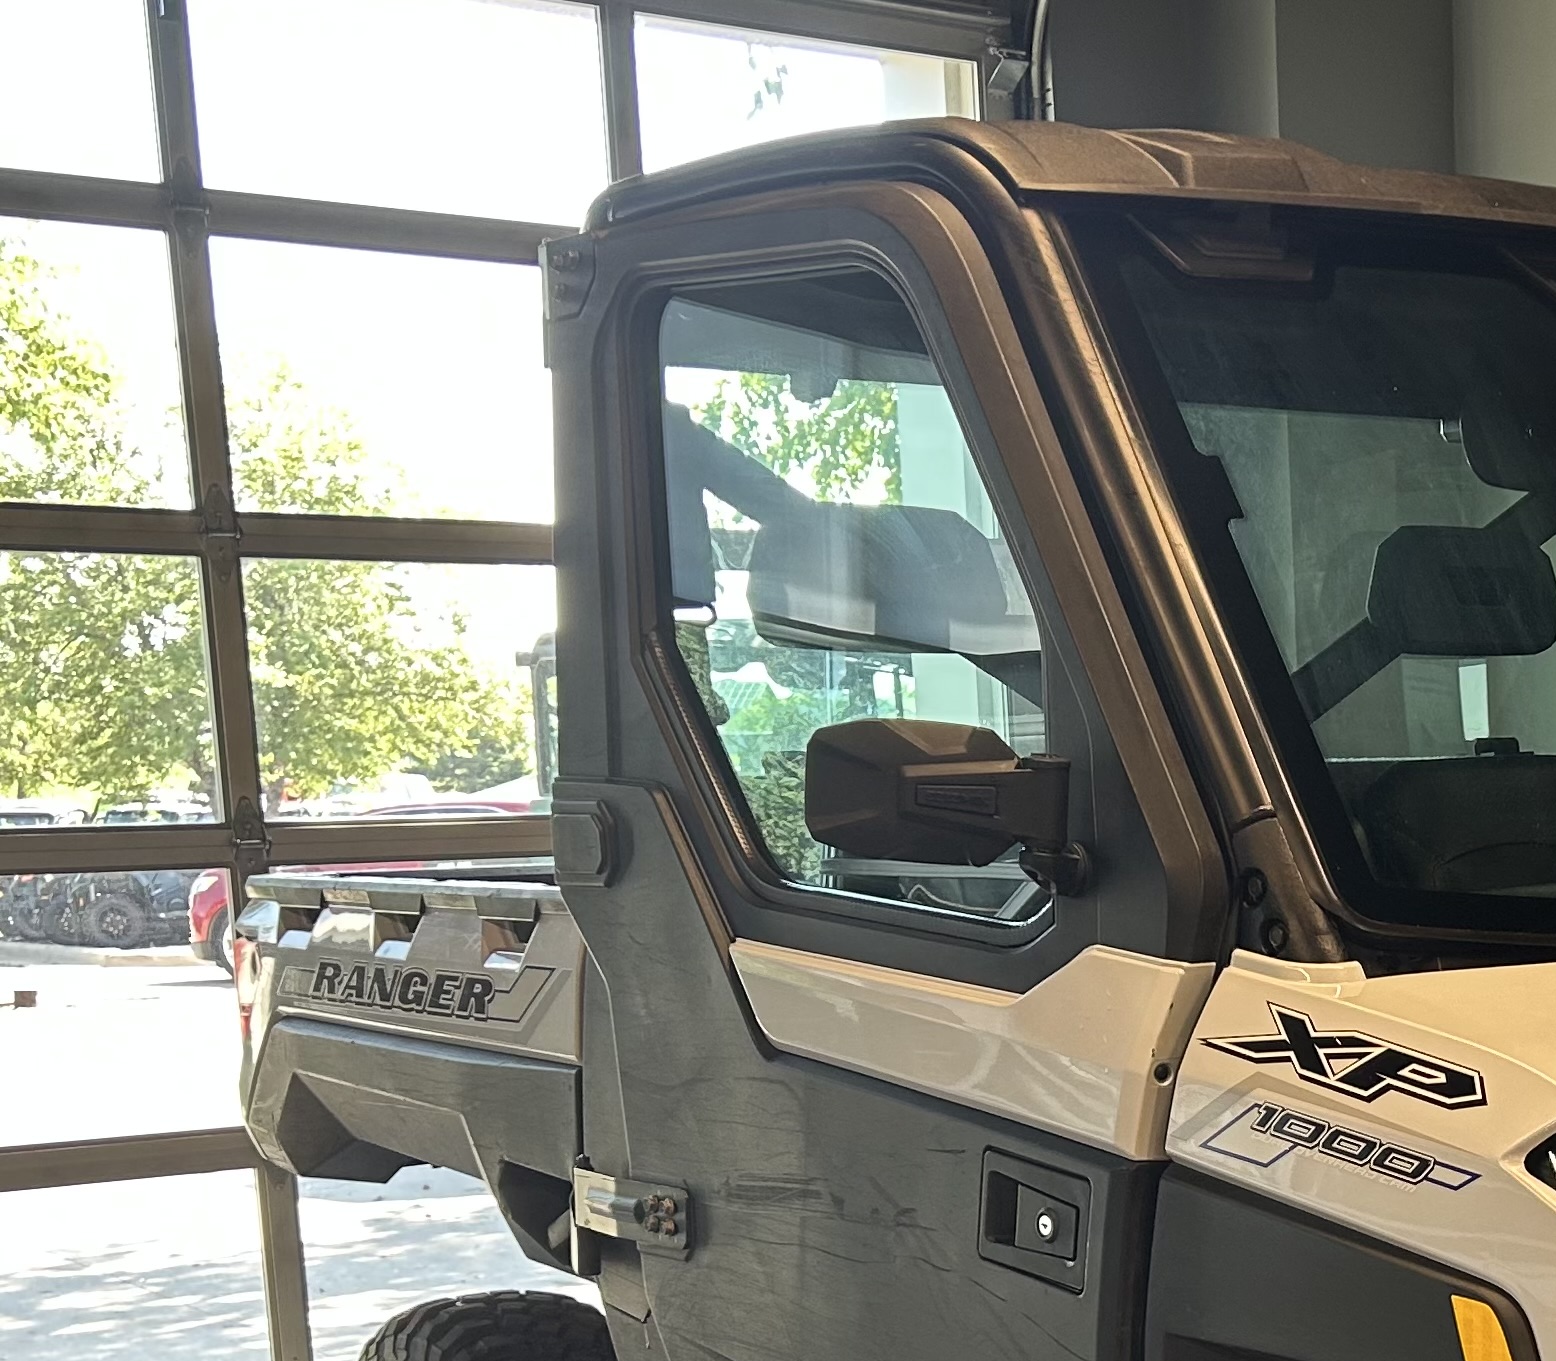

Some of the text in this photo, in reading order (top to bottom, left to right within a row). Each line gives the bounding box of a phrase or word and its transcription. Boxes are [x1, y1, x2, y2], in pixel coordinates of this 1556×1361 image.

[309, 956, 496, 1022] RANGER
[1197, 1000, 1488, 1110] XP
[1251, 1102, 1437, 1184] 1000
